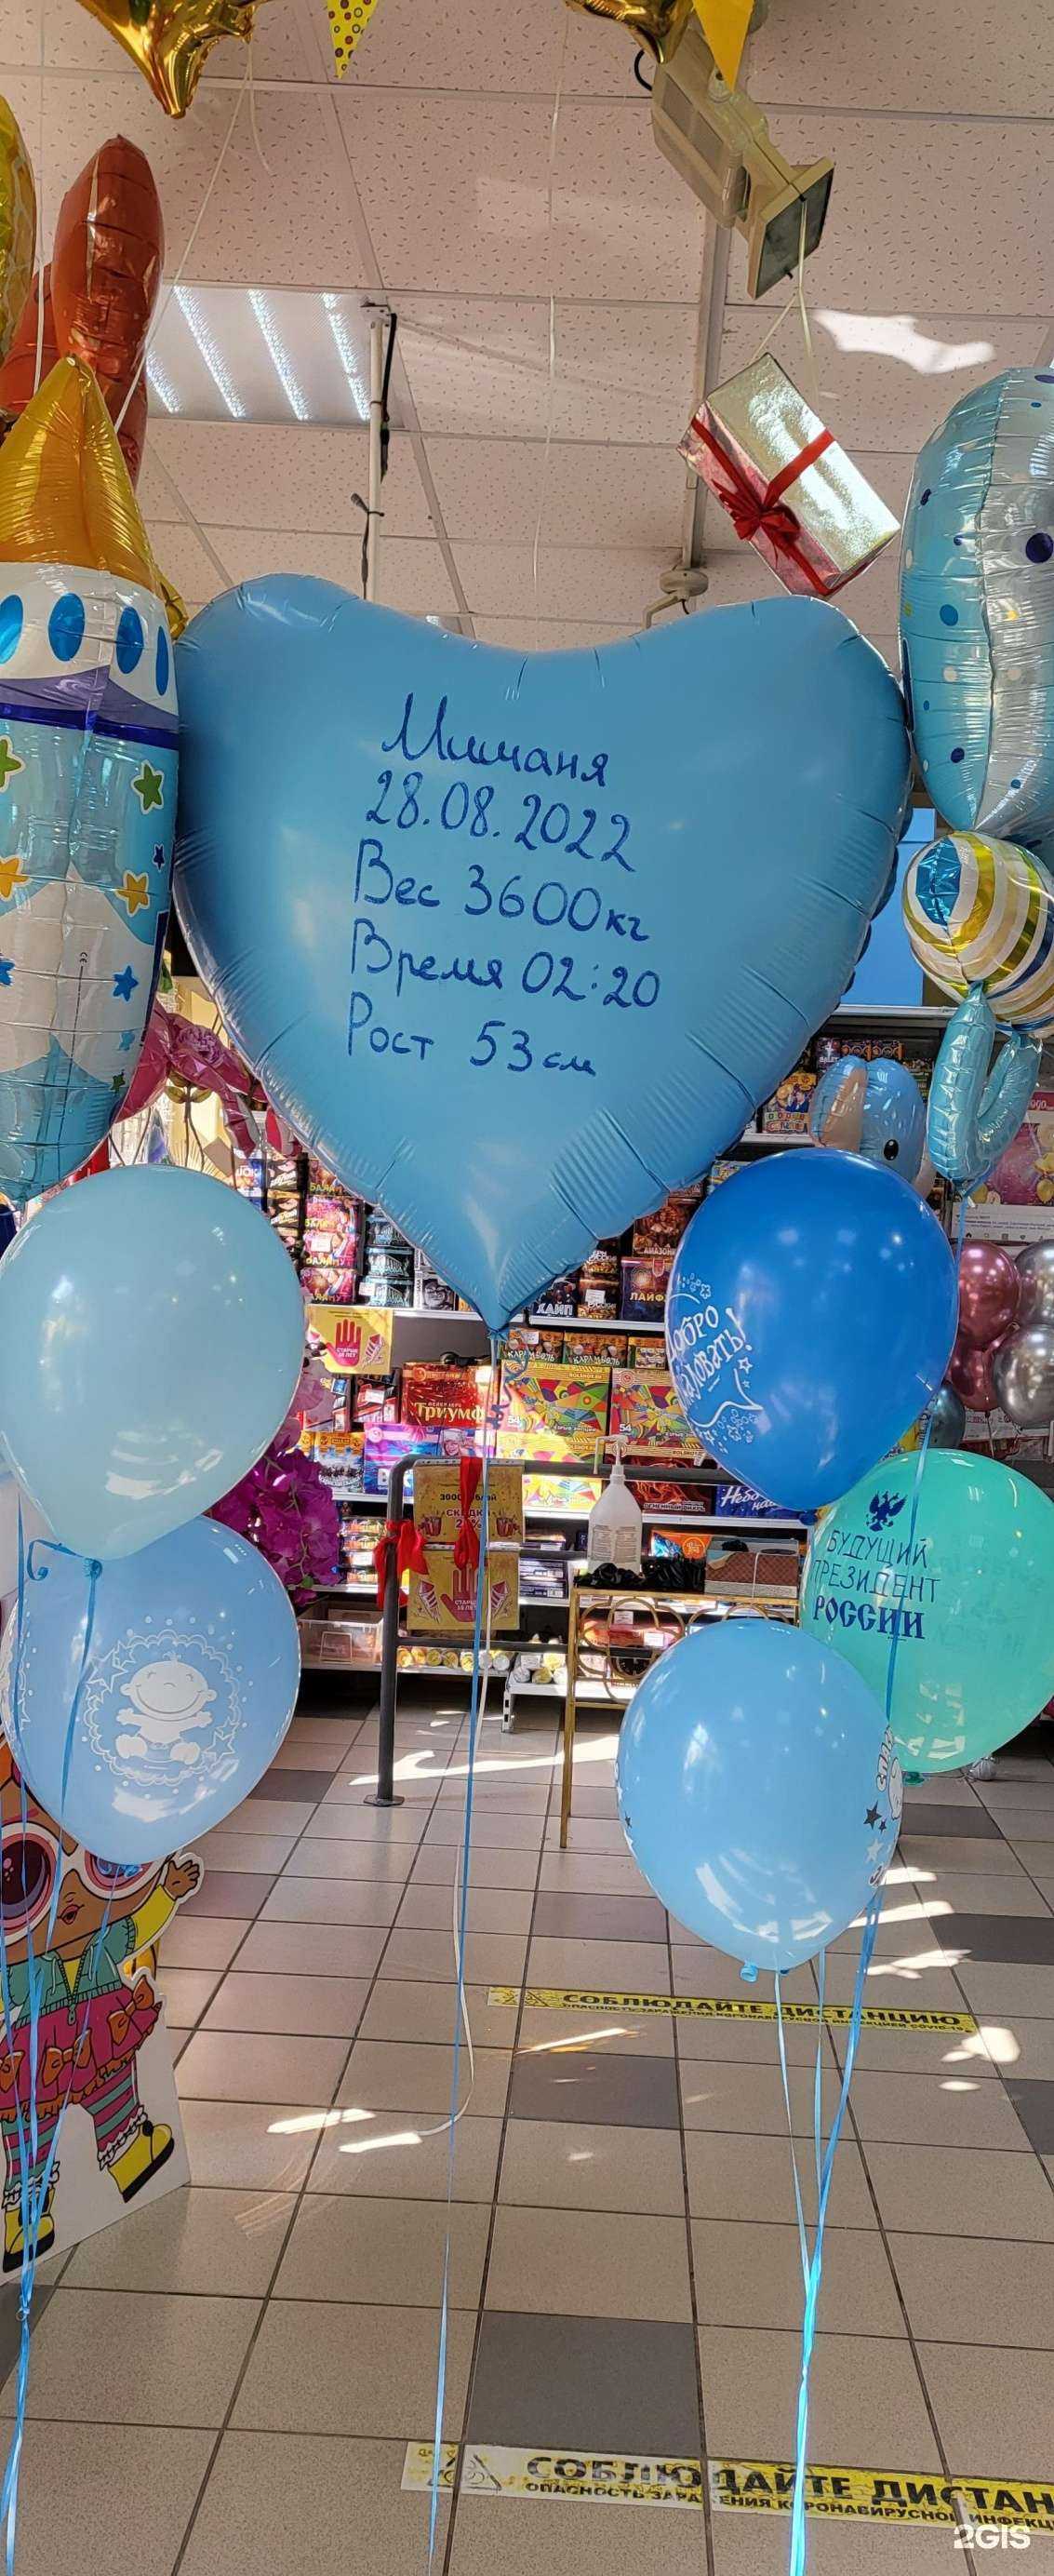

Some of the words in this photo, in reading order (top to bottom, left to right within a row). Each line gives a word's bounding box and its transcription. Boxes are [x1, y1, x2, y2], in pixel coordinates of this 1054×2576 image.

[354, 839, 440, 905] Вес
[351, 918, 502, 997] Время
[522, 951, 660, 1008] 02:20
[348, 991, 434, 1060] Рост
[537, 1304, 573, 1315] ХАЙП
[630, 1293, 667, 1301] ЛАЙФ
[619, 1424, 632, 1432] 54
[446, 1509, 490, 1518] СКДК
[827, 1529, 927, 1568] БУДУЩИЙ
[812, 1559, 941, 1603] ПРЕЗИДЕНТ
[813, 1595, 926, 1640] РОССИИ
[563, 1994, 763, 2015] СОБЛЮДАЙТЕ
[526, 2482, 646, 2499] ОПАСНОСТЬ
[653, 2486, 771, 2509] ЗАРАЕНИЯ
